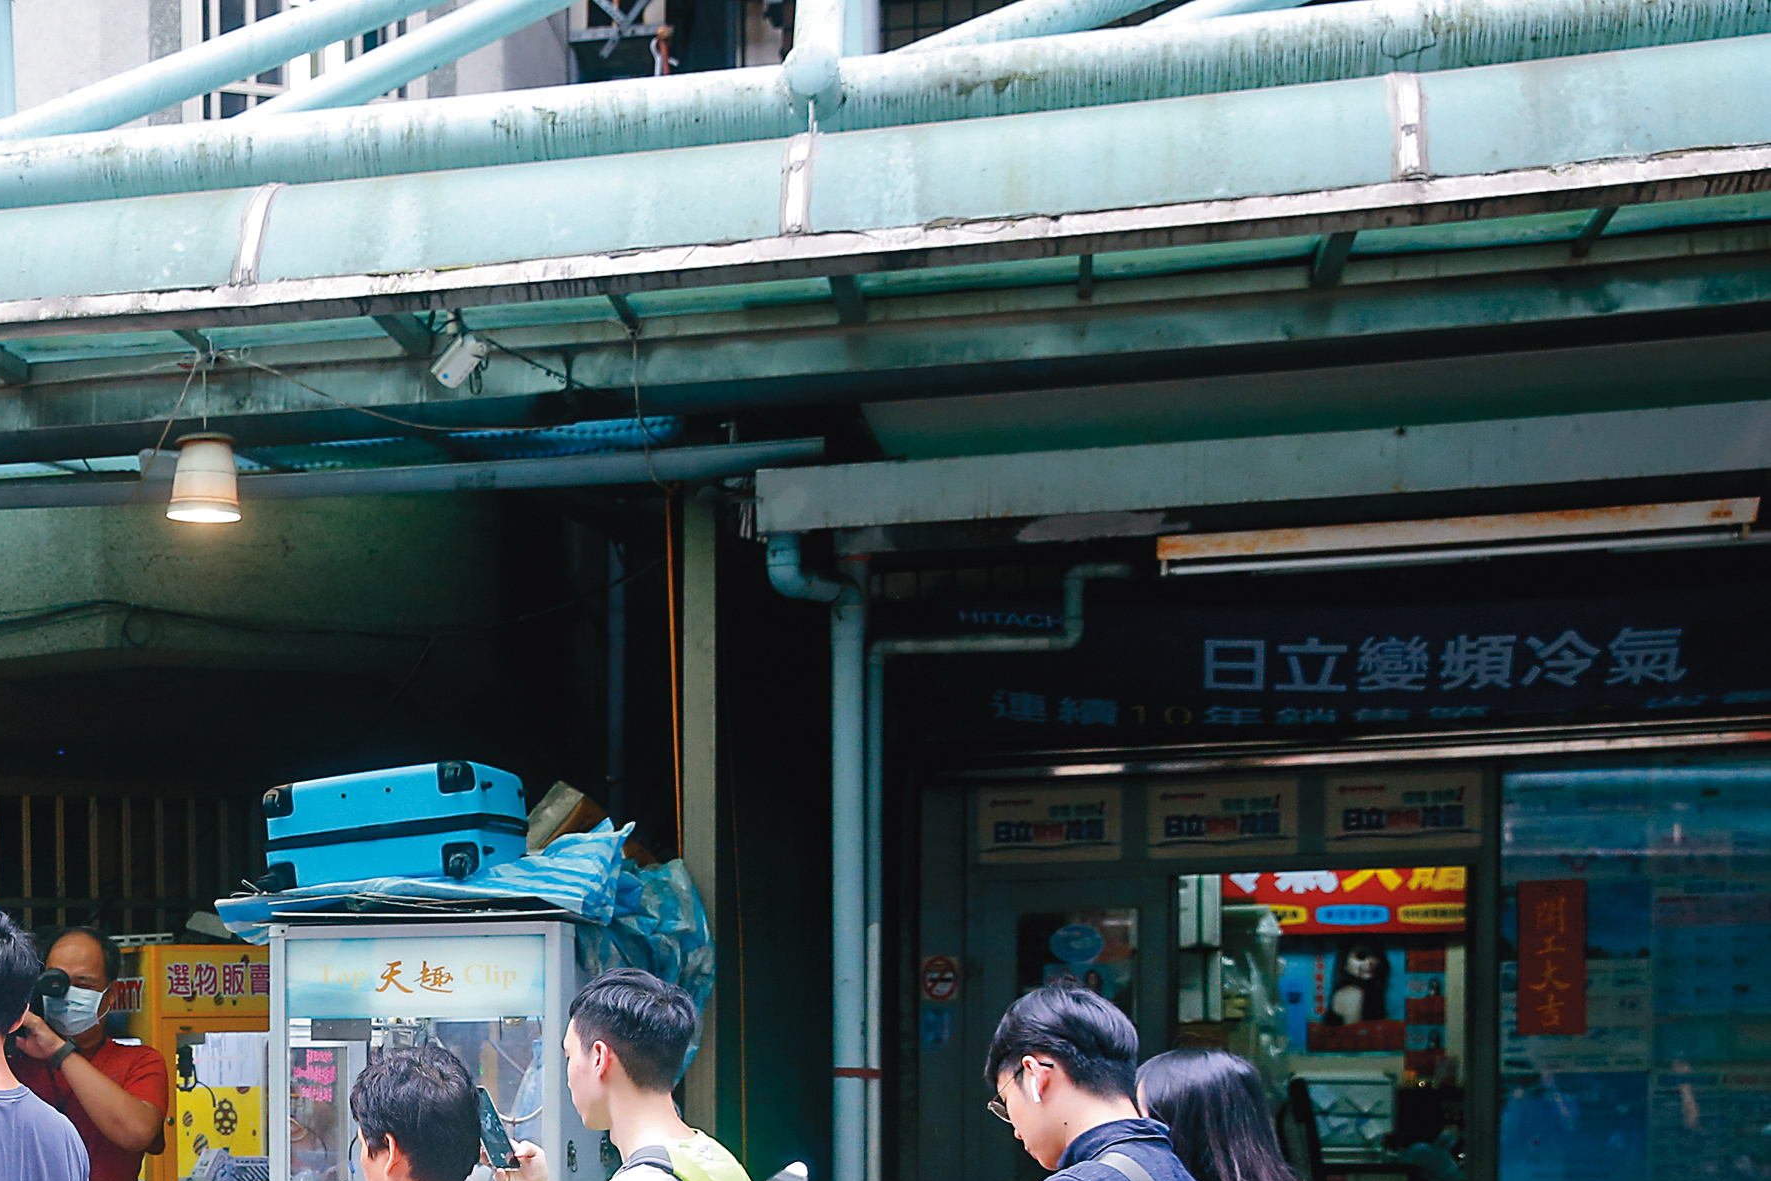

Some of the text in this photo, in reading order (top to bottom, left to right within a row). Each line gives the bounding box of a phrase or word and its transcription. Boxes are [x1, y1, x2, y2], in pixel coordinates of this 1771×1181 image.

[958, 610, 1065, 629] HITACH
[1204, 627, 1687, 692] 日立變頻冷氣
[318, 963, 367, 990] Tap
[463, 963, 518, 990] Clip
[1529, 896, 1571, 1027] 開工大吉
[167, 962, 269, 996] 選物販賣
